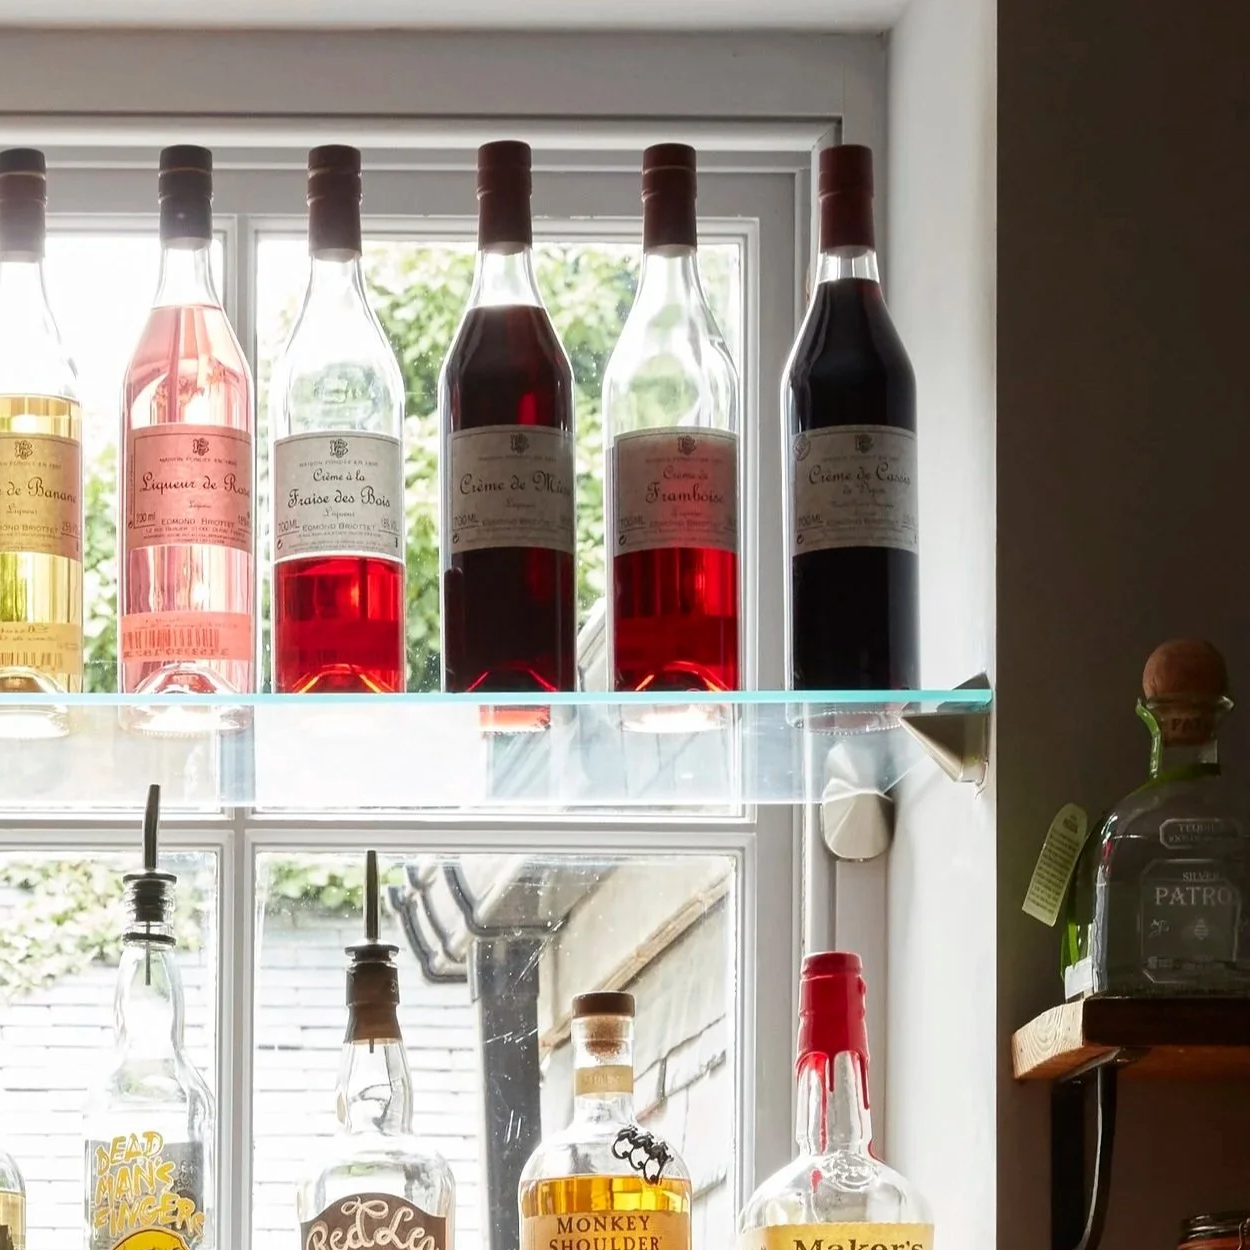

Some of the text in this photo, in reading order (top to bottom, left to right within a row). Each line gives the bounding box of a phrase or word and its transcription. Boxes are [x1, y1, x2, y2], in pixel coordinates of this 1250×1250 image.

[139, 472, 196, 495] Liqueur
[202, 475, 217, 489] de
[313, 468, 365, 481] Crème à la
[460, 472, 526, 495] Crème de
[809, 465, 851, 485] Crème
[7, 481, 21, 496] de
[28, 476, 76, 503] Banane
[288, 485, 390, 508] Fraise des Bois
[645, 482, 724, 503] Framboise
[95, 1131, 165, 1177] DEAD
[94, 1192, 205, 1240] FINGERS
[557, 1216, 650, 1234] MONKEY
